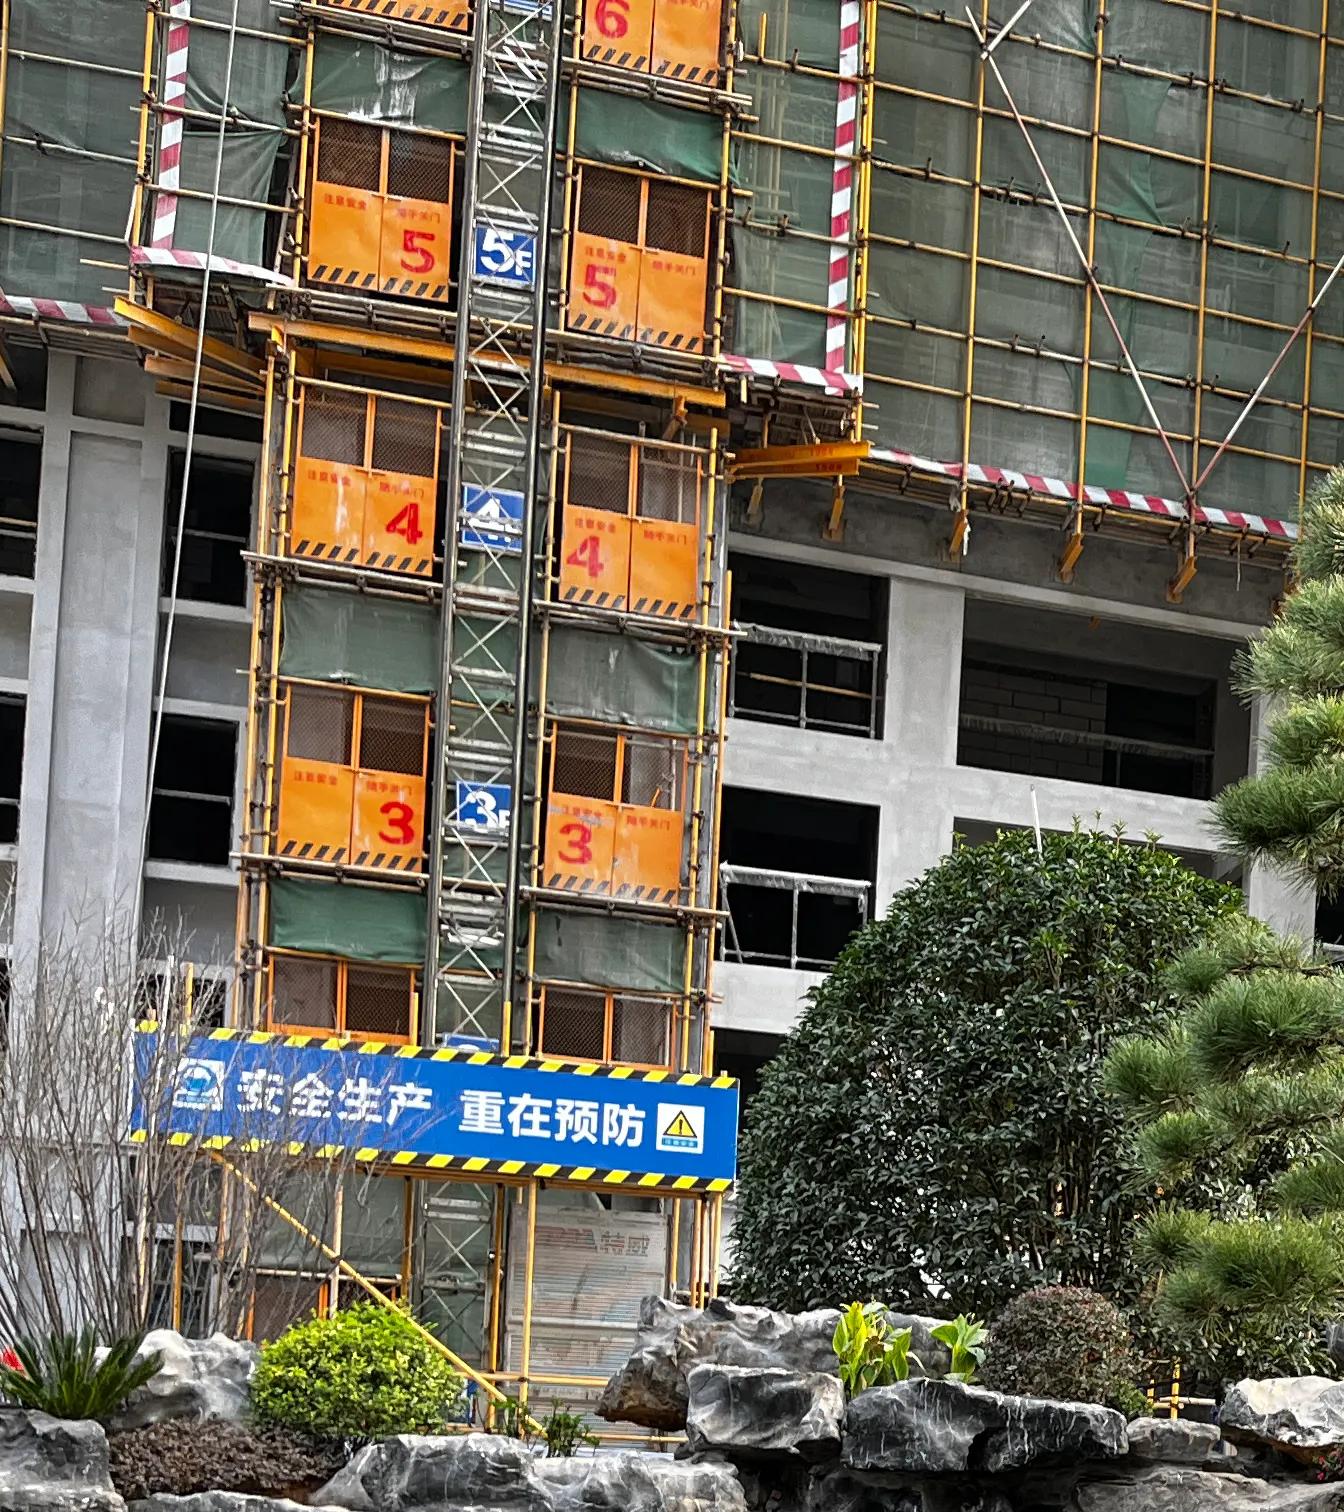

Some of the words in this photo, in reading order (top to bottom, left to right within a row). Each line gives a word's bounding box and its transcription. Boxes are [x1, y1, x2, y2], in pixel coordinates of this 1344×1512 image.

[594, 0, 630, 39] 6
[400, 229, 435, 274] 5
[480, 229, 532, 276] 5F
[582, 263, 616, 310] 5
[385, 502, 423, 545] 4
[566, 535, 604, 578] 4
[378, 801, 415, 845] 3
[558, 823, 592, 865] 3
[236, 1068, 433, 1125] 安全生产
[458, 1089, 646, 1148] 重在预防
